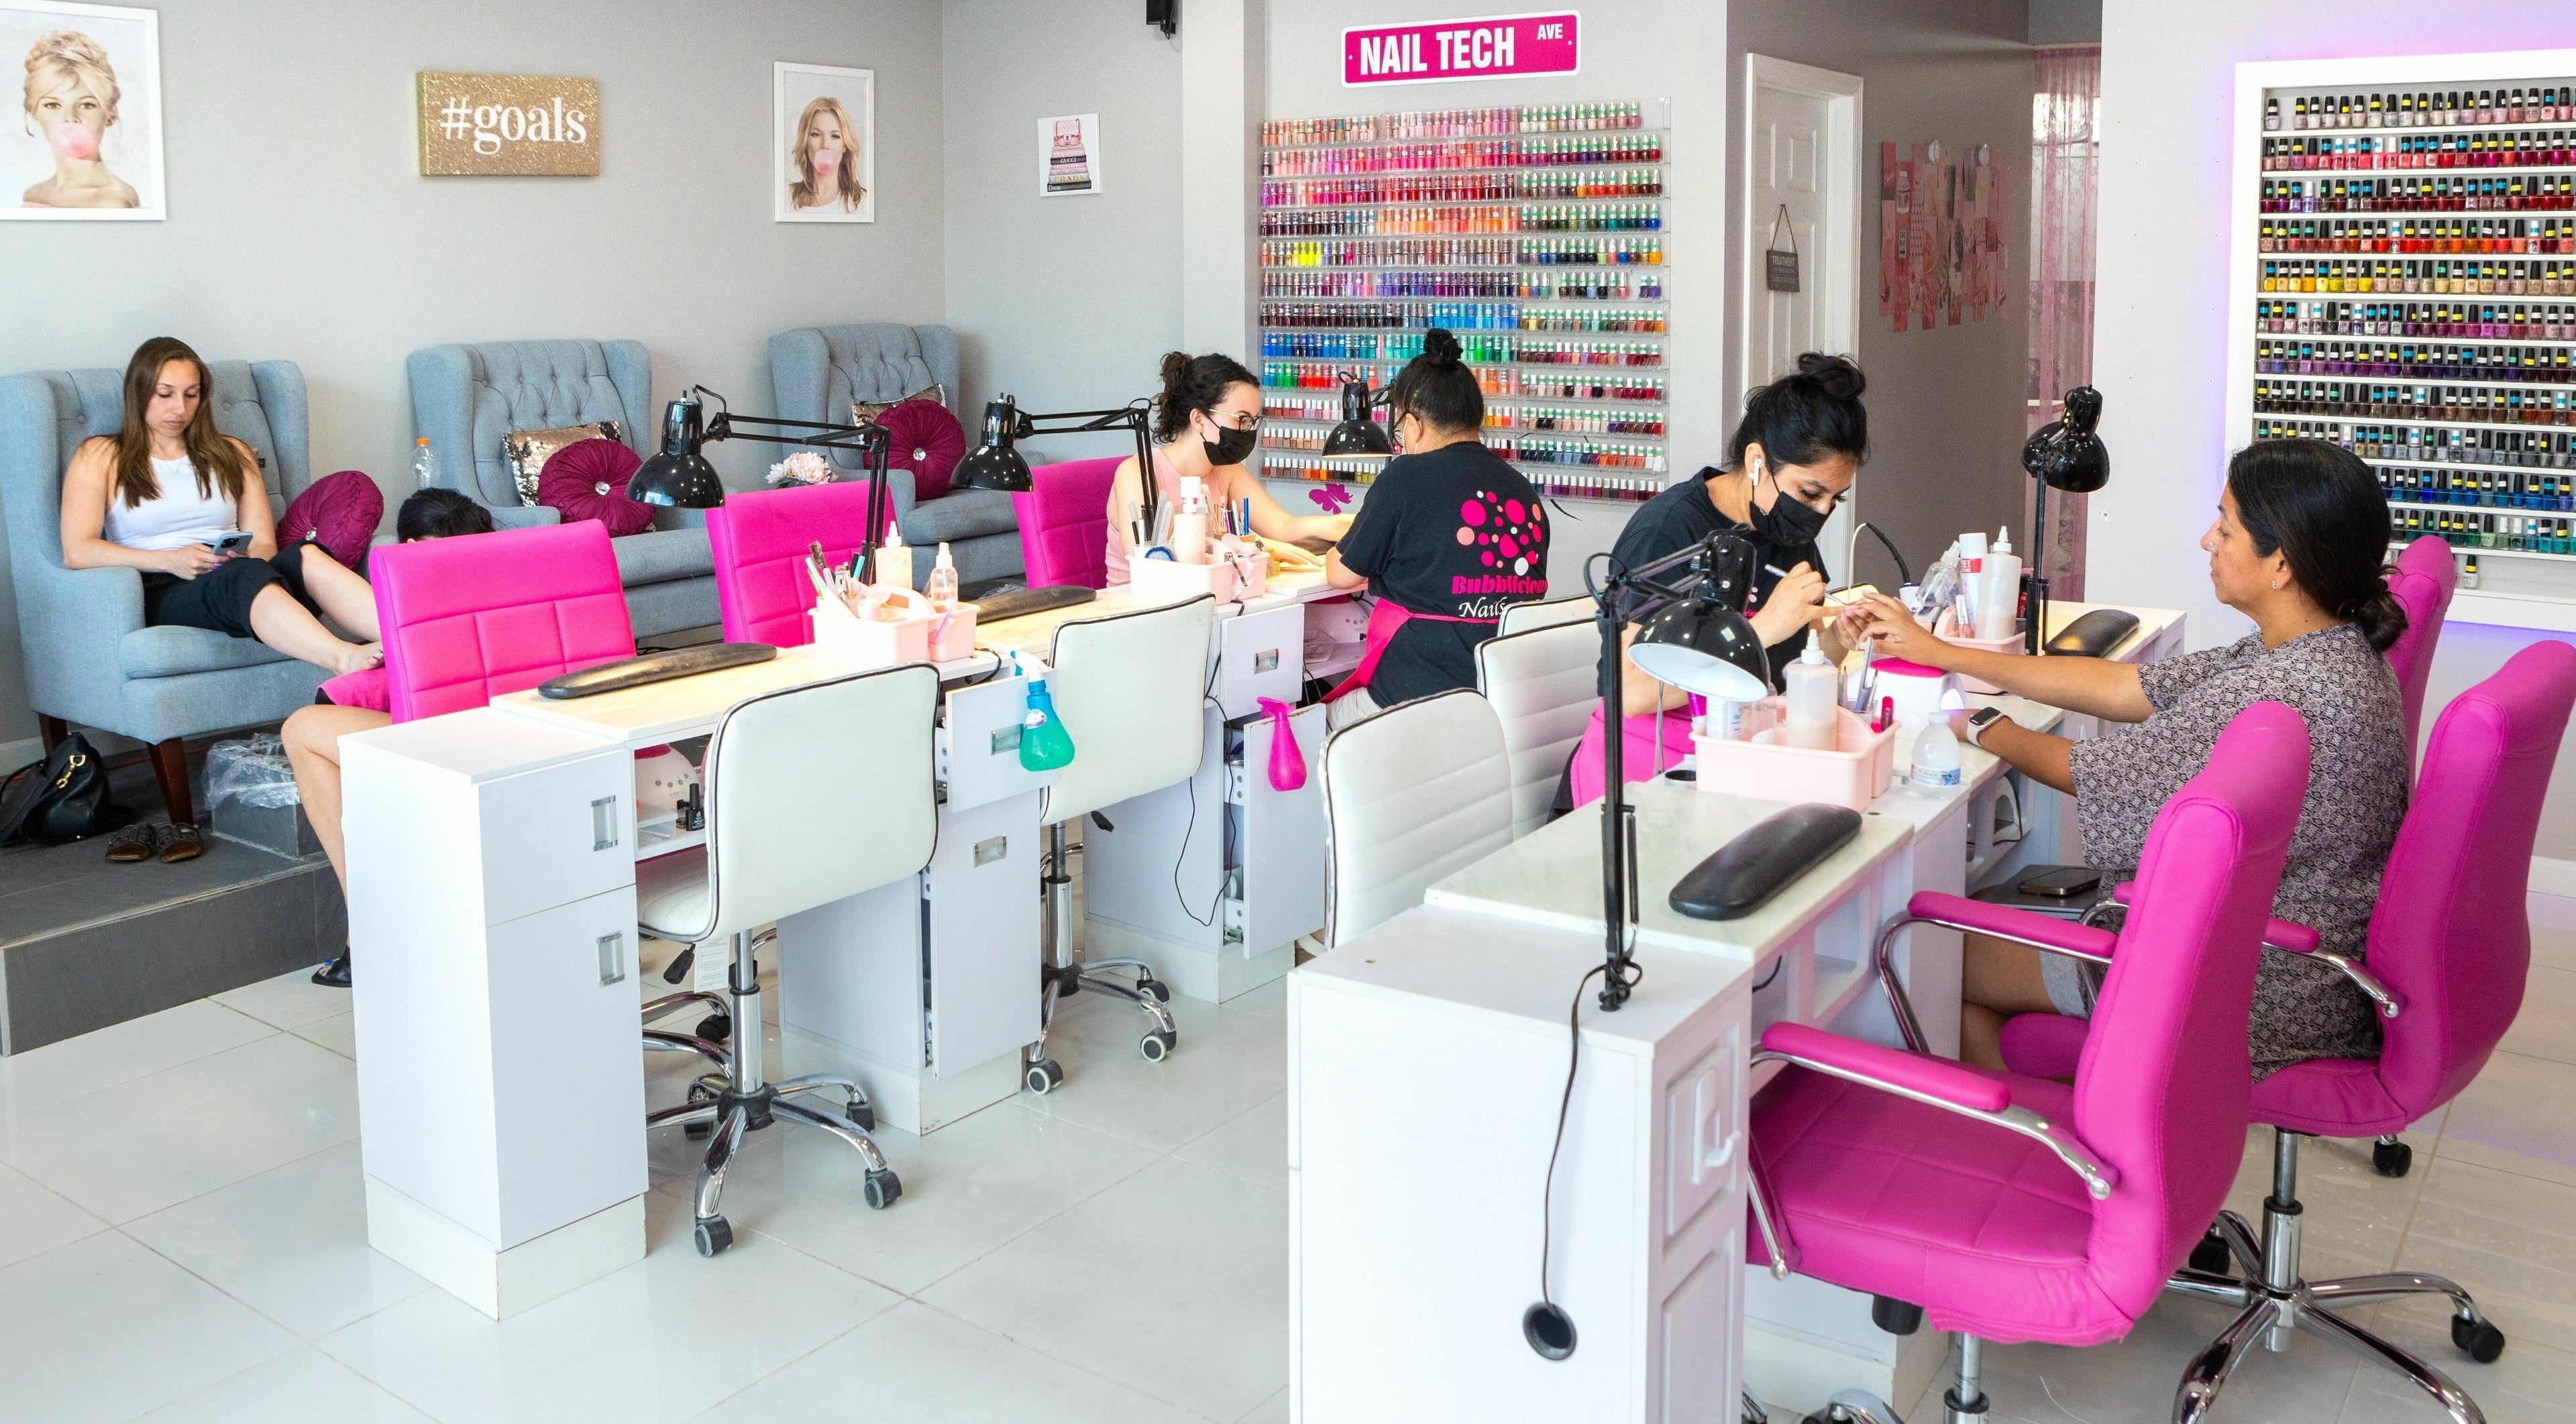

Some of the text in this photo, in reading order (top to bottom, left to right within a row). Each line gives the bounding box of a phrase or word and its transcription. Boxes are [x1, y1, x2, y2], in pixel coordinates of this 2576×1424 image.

[1360, 23, 1563, 75] NAIL TECH AVE
[440, 97, 587, 155] #goals
[1053, 175, 1085, 183] PRADA
[1458, 596, 1507, 618] Nails
